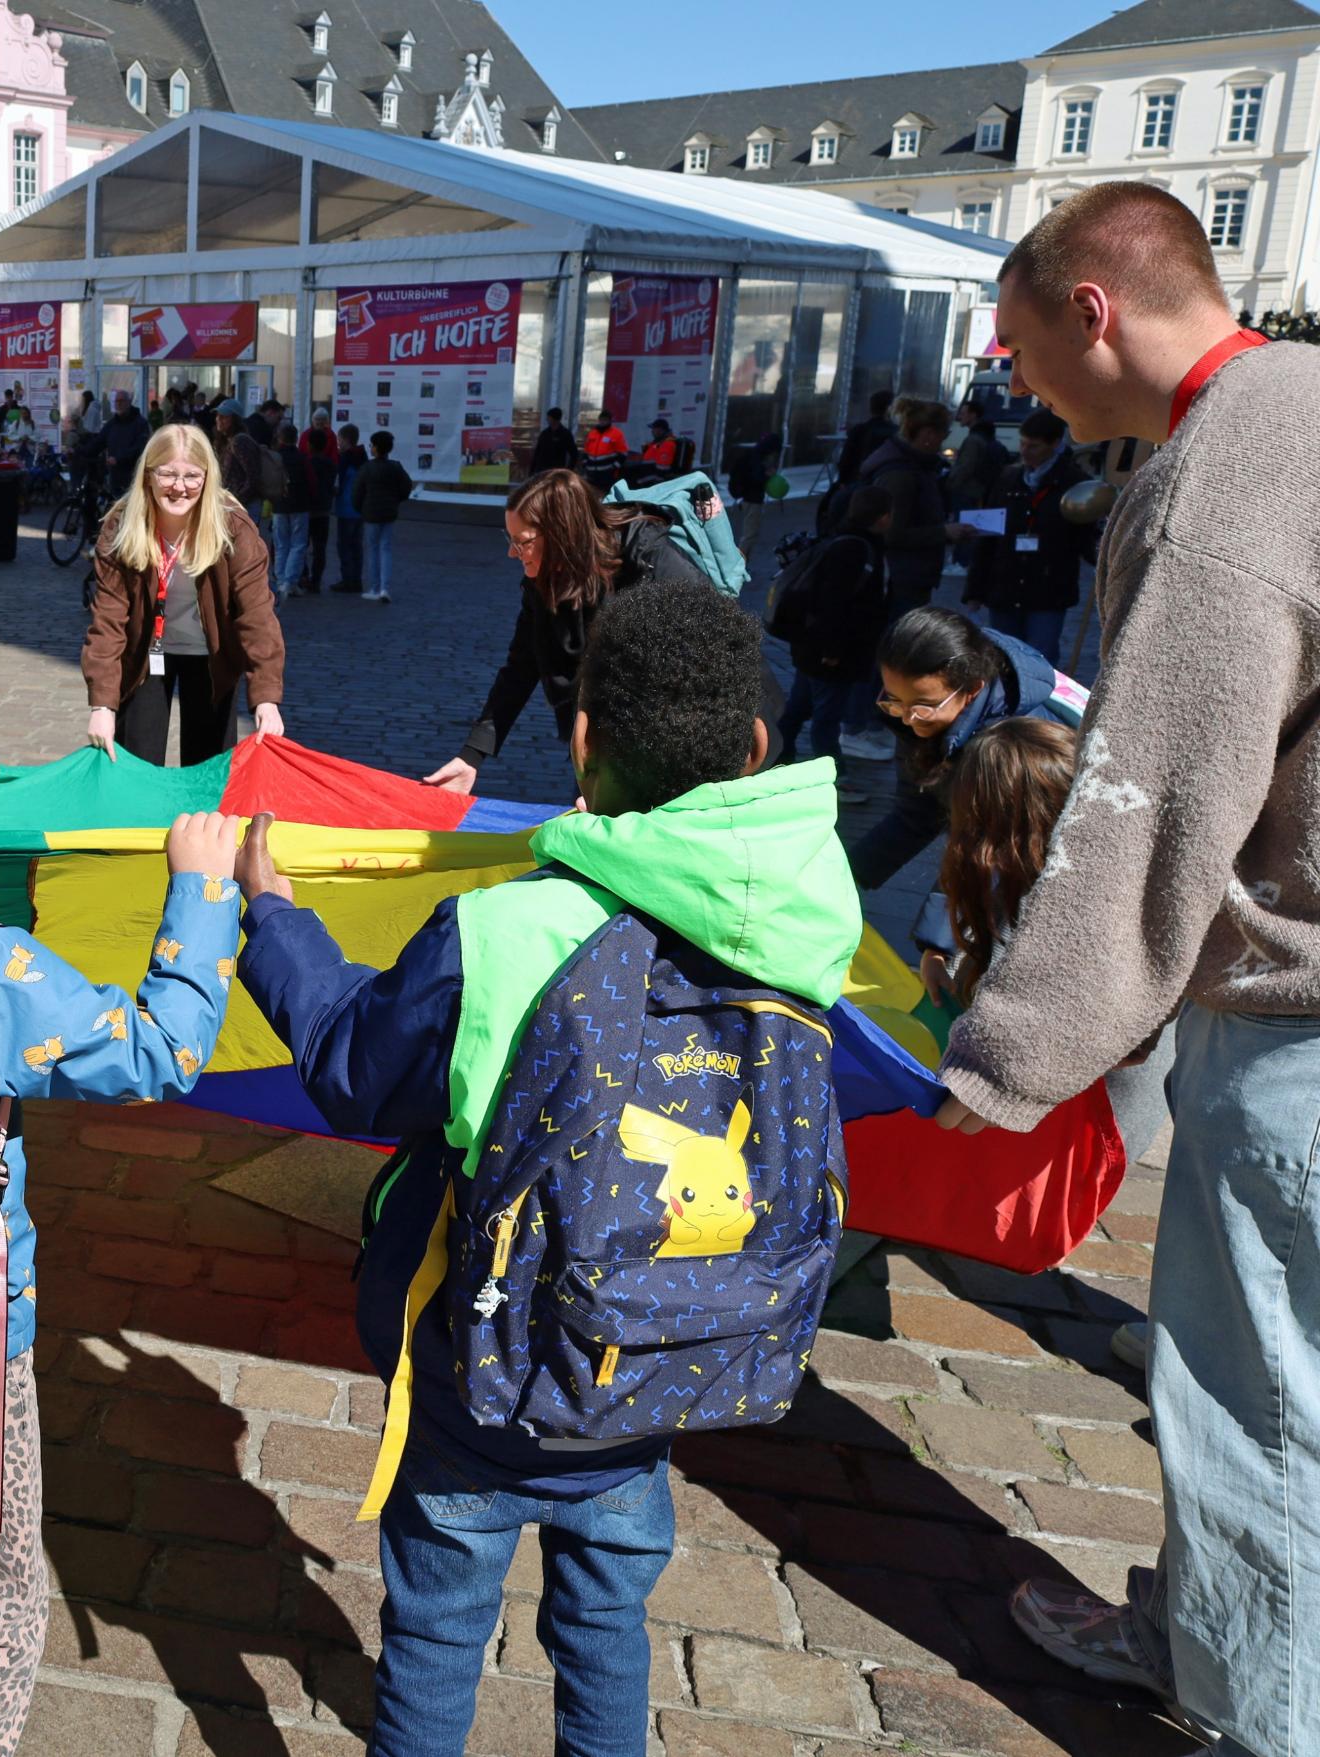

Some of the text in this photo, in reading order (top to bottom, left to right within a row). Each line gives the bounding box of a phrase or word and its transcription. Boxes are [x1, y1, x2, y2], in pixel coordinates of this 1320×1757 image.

[376, 287, 449, 301] KULTURBÜHNE
[419, 305, 479, 323] UNBEGREIFLICH
[196, 328, 238, 336] WILLKOMMEN
[389, 329, 427, 362] ICH
[434, 312, 510, 352] HOFFE
[644, 307, 712, 353] ICH HOFFE
[6, 327, 56, 358] HOFFE
